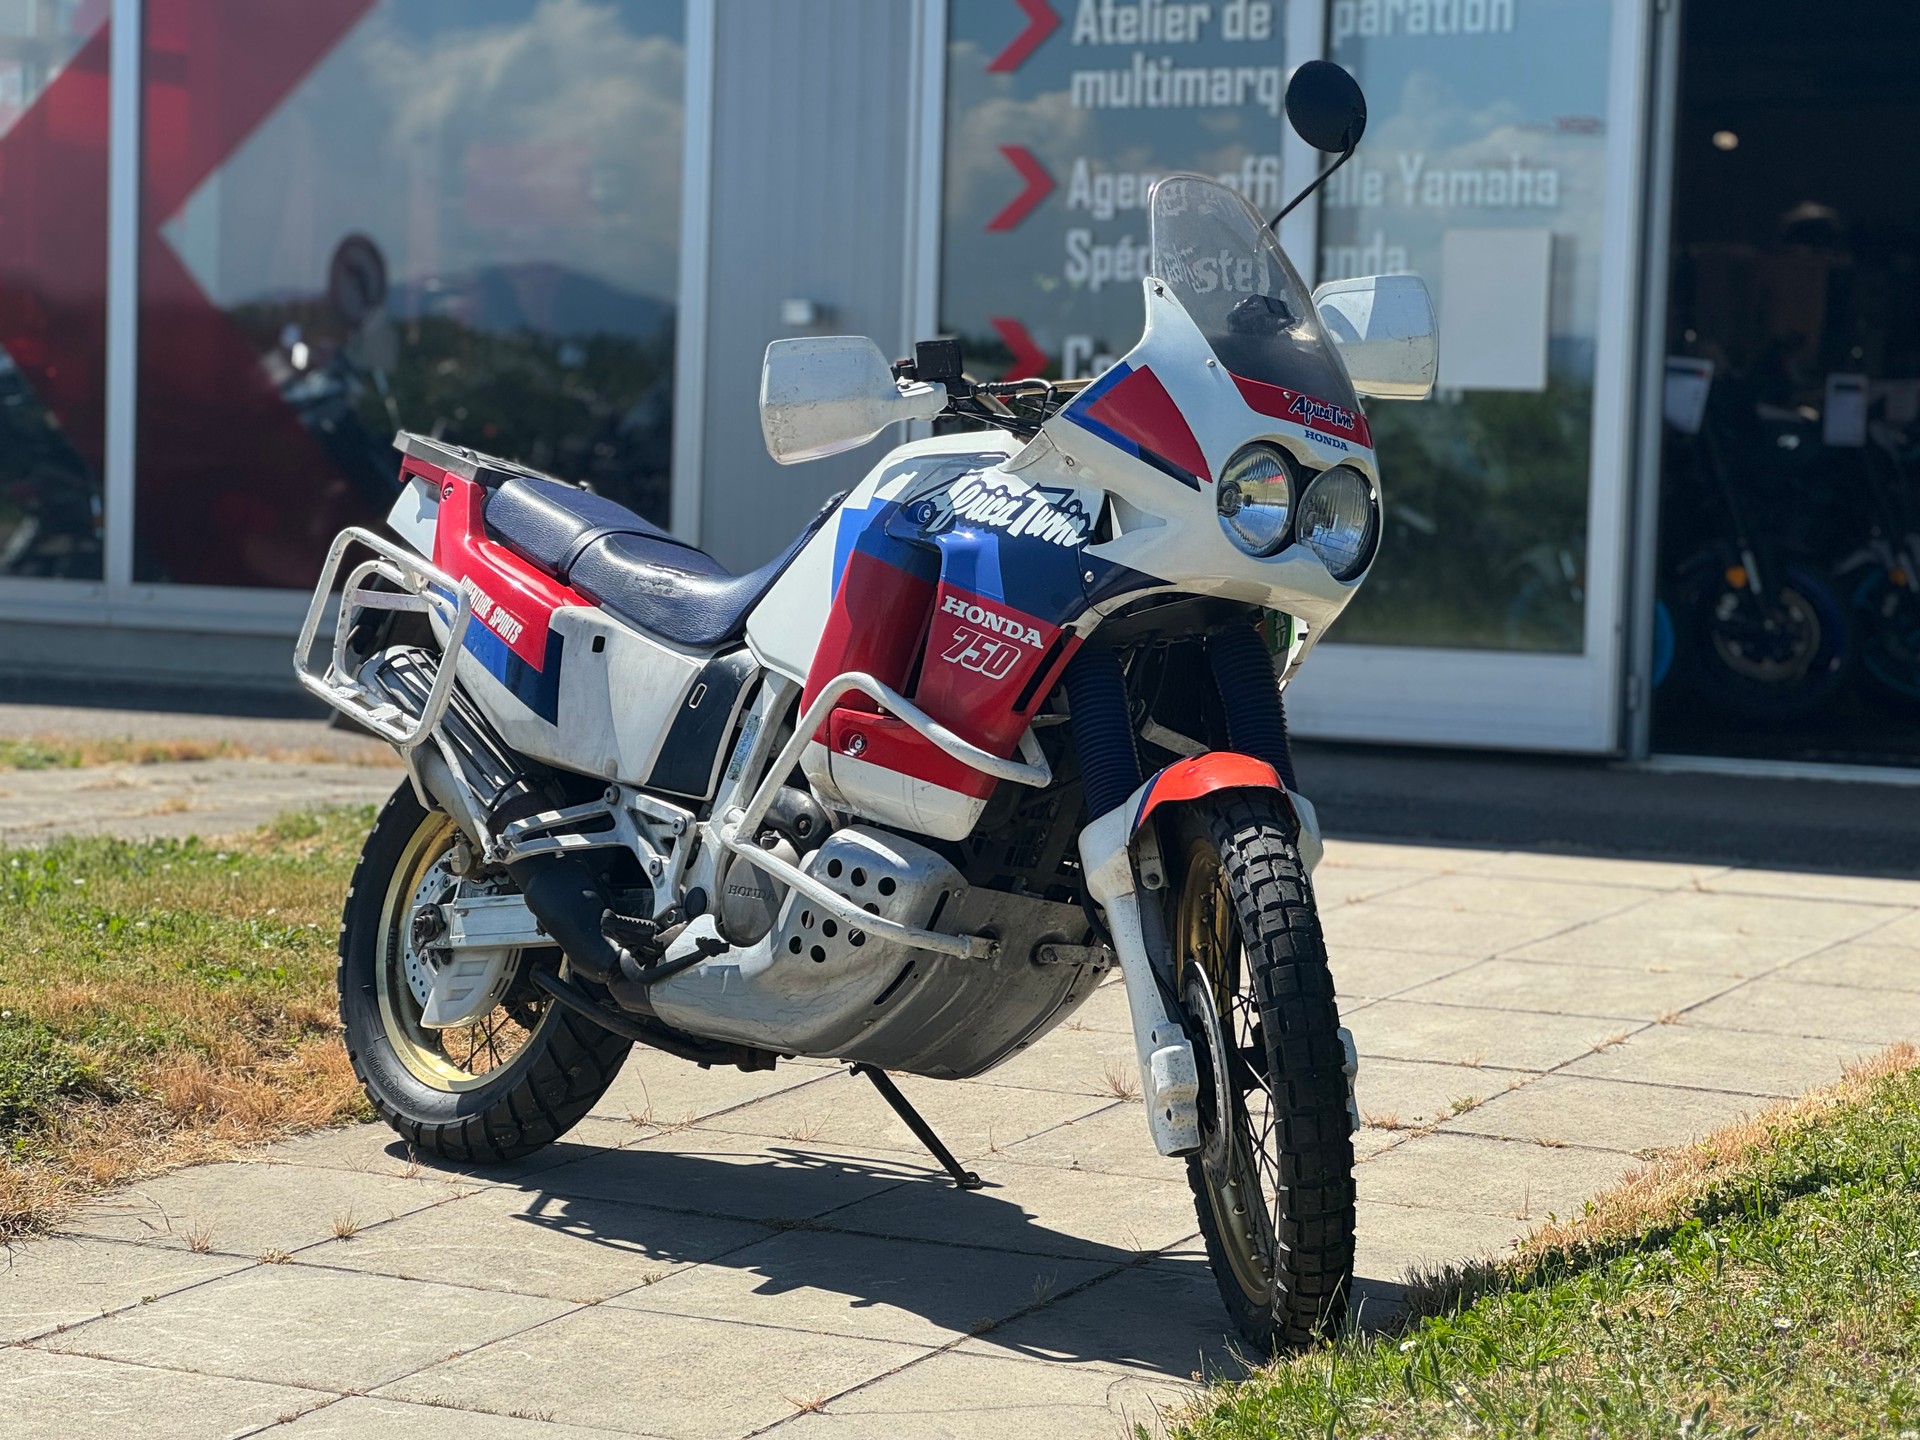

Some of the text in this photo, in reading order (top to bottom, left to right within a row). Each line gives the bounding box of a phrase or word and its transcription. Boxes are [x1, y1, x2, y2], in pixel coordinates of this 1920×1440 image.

[1071, 0, 1514, 47] Atelier de paration
[1070, 52, 1281, 116] multimarq
[1398, 152, 1559, 207] Yamaha
[1304, 429, 1349, 451] HONDA
[487, 606, 524, 645] SPORTS
[940, 595, 1044, 650] HONDA
[940, 625, 1022, 680] 750
[728, 884, 775, 901] HONDA
